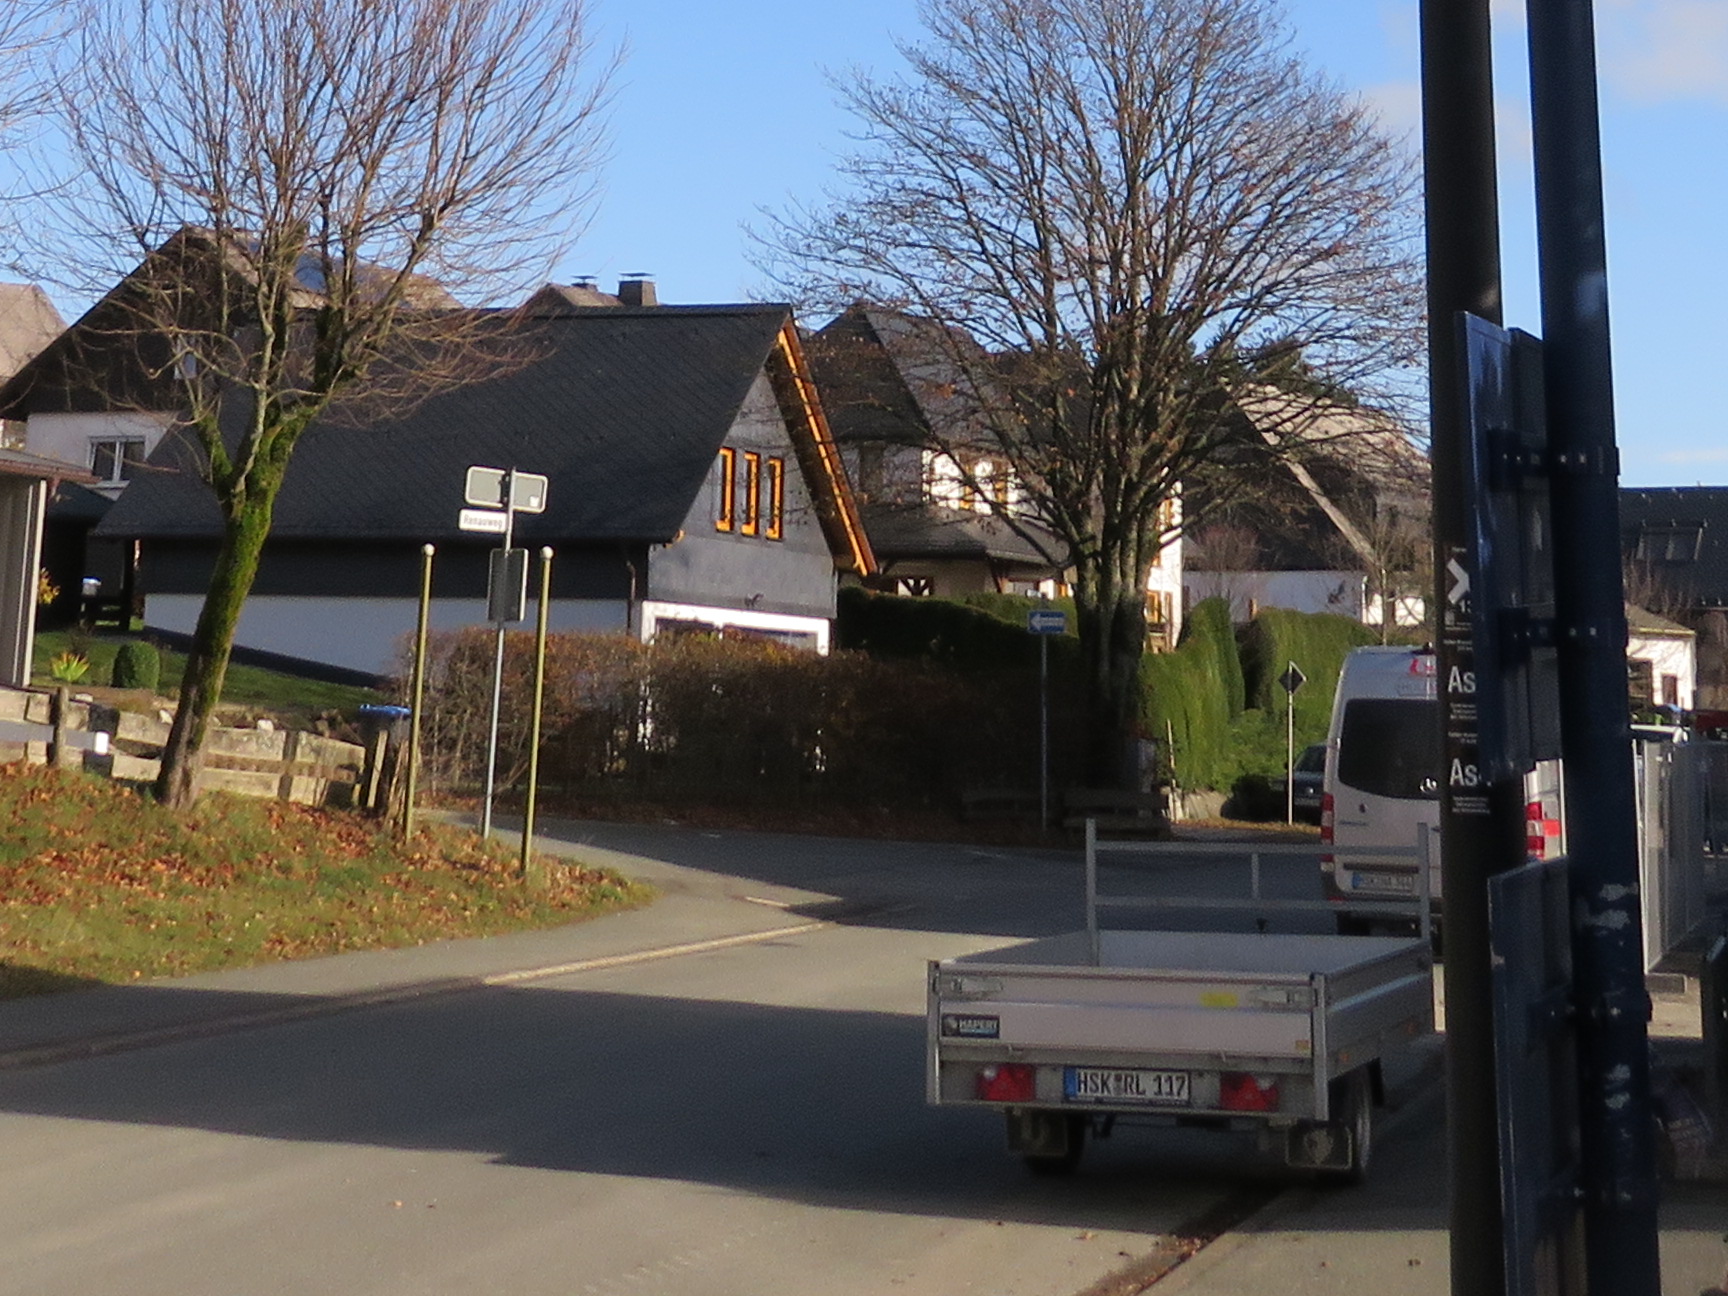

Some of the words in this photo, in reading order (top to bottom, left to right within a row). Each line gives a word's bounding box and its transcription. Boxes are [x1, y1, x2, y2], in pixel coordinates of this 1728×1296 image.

[1078, 1071, 1112, 1095] HSK
[1124, 1073, 1147, 1095] RL
[1152, 1074, 1186, 1096] 117
